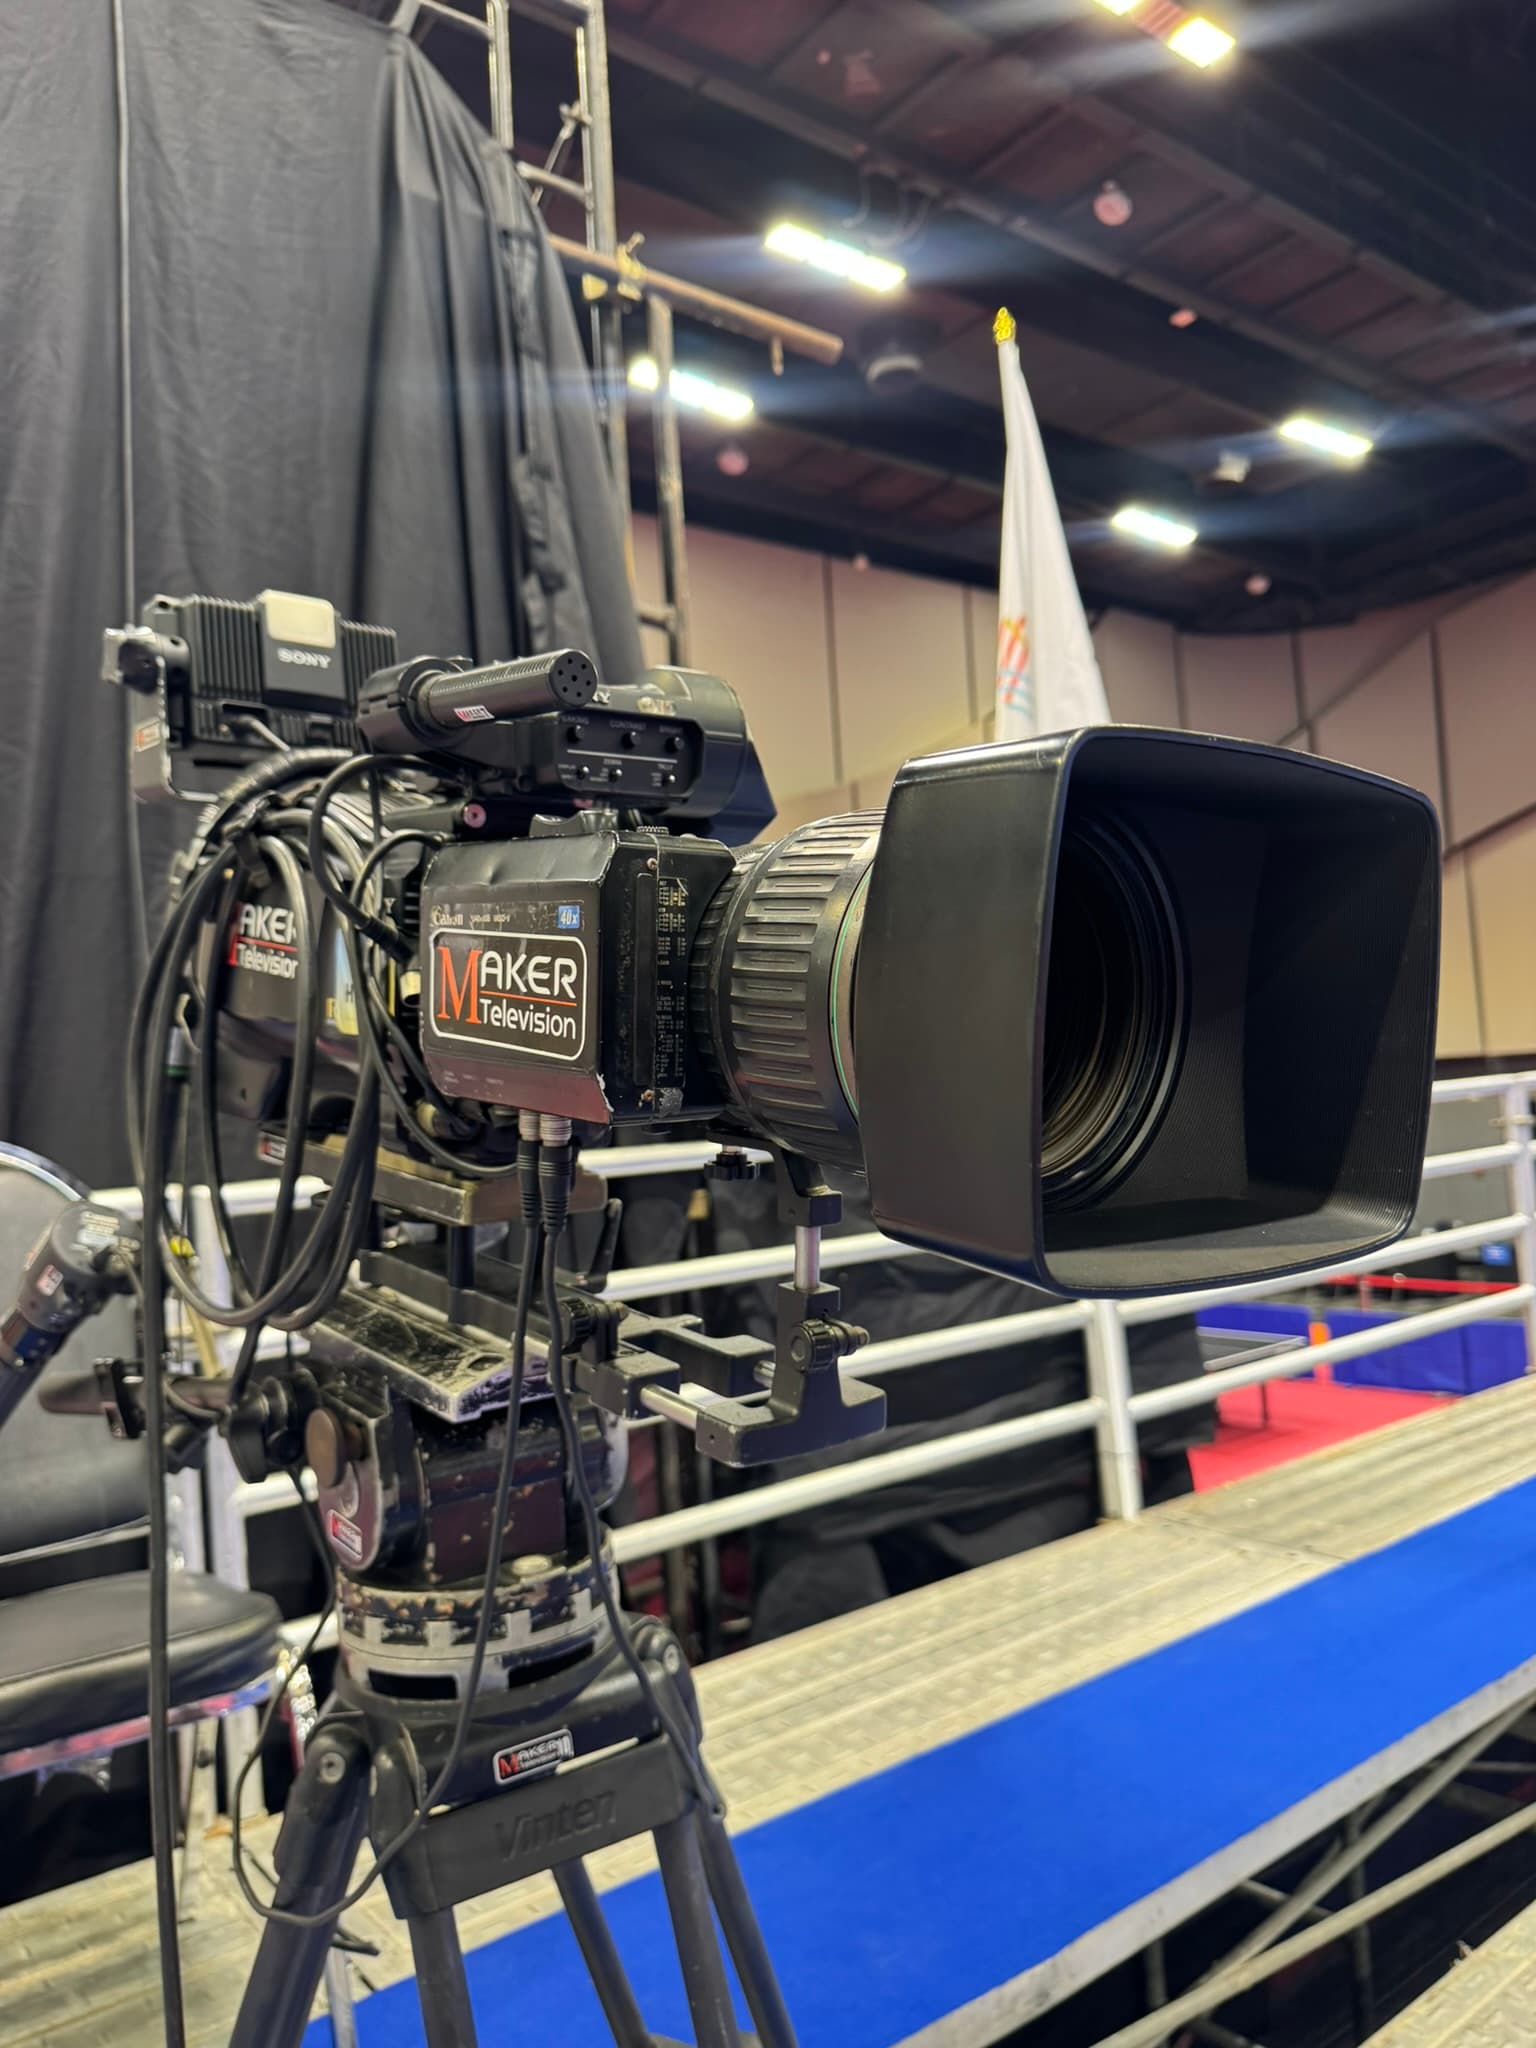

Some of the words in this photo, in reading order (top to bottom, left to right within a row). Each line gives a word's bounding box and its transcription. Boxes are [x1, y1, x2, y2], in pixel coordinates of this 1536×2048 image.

[277, 648, 331, 669] SONY
[560, 909, 577, 925] 40x
[436, 946, 577, 1024] MAKER
[480, 998, 576, 1040] Television
[495, 1790, 617, 1862] Vinten
